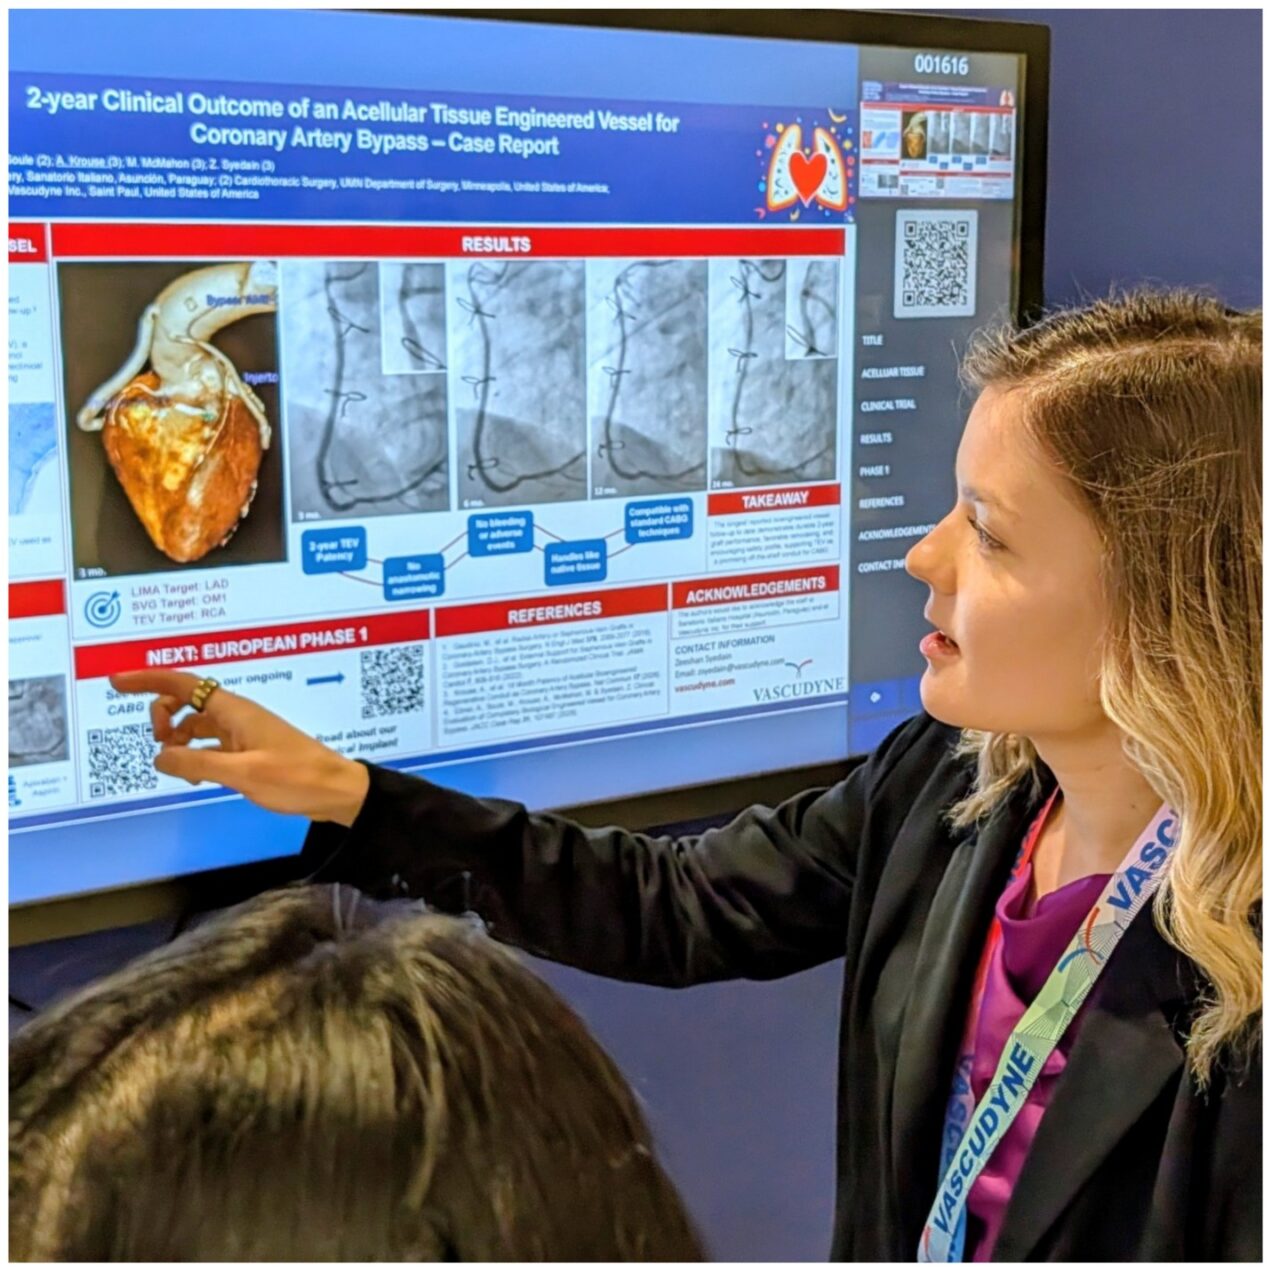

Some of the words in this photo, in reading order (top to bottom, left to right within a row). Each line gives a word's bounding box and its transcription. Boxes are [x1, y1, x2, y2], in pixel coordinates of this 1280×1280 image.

[914, 54, 969, 75] 001616
[26, 86, 97, 114] 2-year
[102, 89, 183, 114] Clinical
[187, 93, 284, 118] Outcome
[288, 97, 310, 118] of
[313, 102, 339, 120] an
[342, 99, 426, 124] Acellular
[430, 102, 492, 126] Tissue
[495, 106, 594, 132] Engineered
[597, 110, 652, 133] Vessel
[655, 113, 680, 133] for
[190, 122, 287, 152] Coronary
[291, 126, 352, 153] Artery
[357, 129, 429, 155] Bypass
[448, 132, 495, 153] Case
[499, 135, 560, 158] Report
[461, 236, 532, 254] RESULTS
[862, 334, 883, 346] TITLE
[900, 365, 925, 377] TISSUE
[861, 400, 894, 412] CLINICAL
[895, 399, 917, 410] TRIAL
[860, 432, 892, 444] RESULTS
[860, 466, 884, 477] PHASE
[742, 491, 810, 509] TAKEAWAY
[859, 495, 905, 509] REFERENCES
[858, 524, 936, 540] ACKNOWLEDGEMENT
[340, 538, 360, 548] TEV
[858, 560, 892, 573] CONTACT
[131, 585, 160, 597] LIMA
[162, 581, 201, 596] Target:
[204, 578, 230, 591] LAD
[686, 575, 826, 604] ACKNOWLEDGEMENTS
[132, 599, 158, 611] SVG
[160, 596, 199, 611] Target:
[508, 601, 602, 624] REFERENCES
[132, 615, 156, 626] TEV
[159, 610, 198, 625] Target:
[201, 608, 226, 620] RCA
[146, 646, 199, 667] NEXT:
[203, 635, 297, 661] EUROPEAN
[300, 631, 356, 650] PHASE
[358, 627, 369, 642] 1
[675, 641, 716, 655] CONTACT
[718, 635, 776, 650] INFORMATION
[246, 670, 293, 688] ongoing
[675, 678, 735, 693] vascudyne.com
[753, 677, 844, 702] VASCUDYNE
[107, 701, 145, 716] CABG
[933, 1043, 1035, 1234] VASCUDYNE
